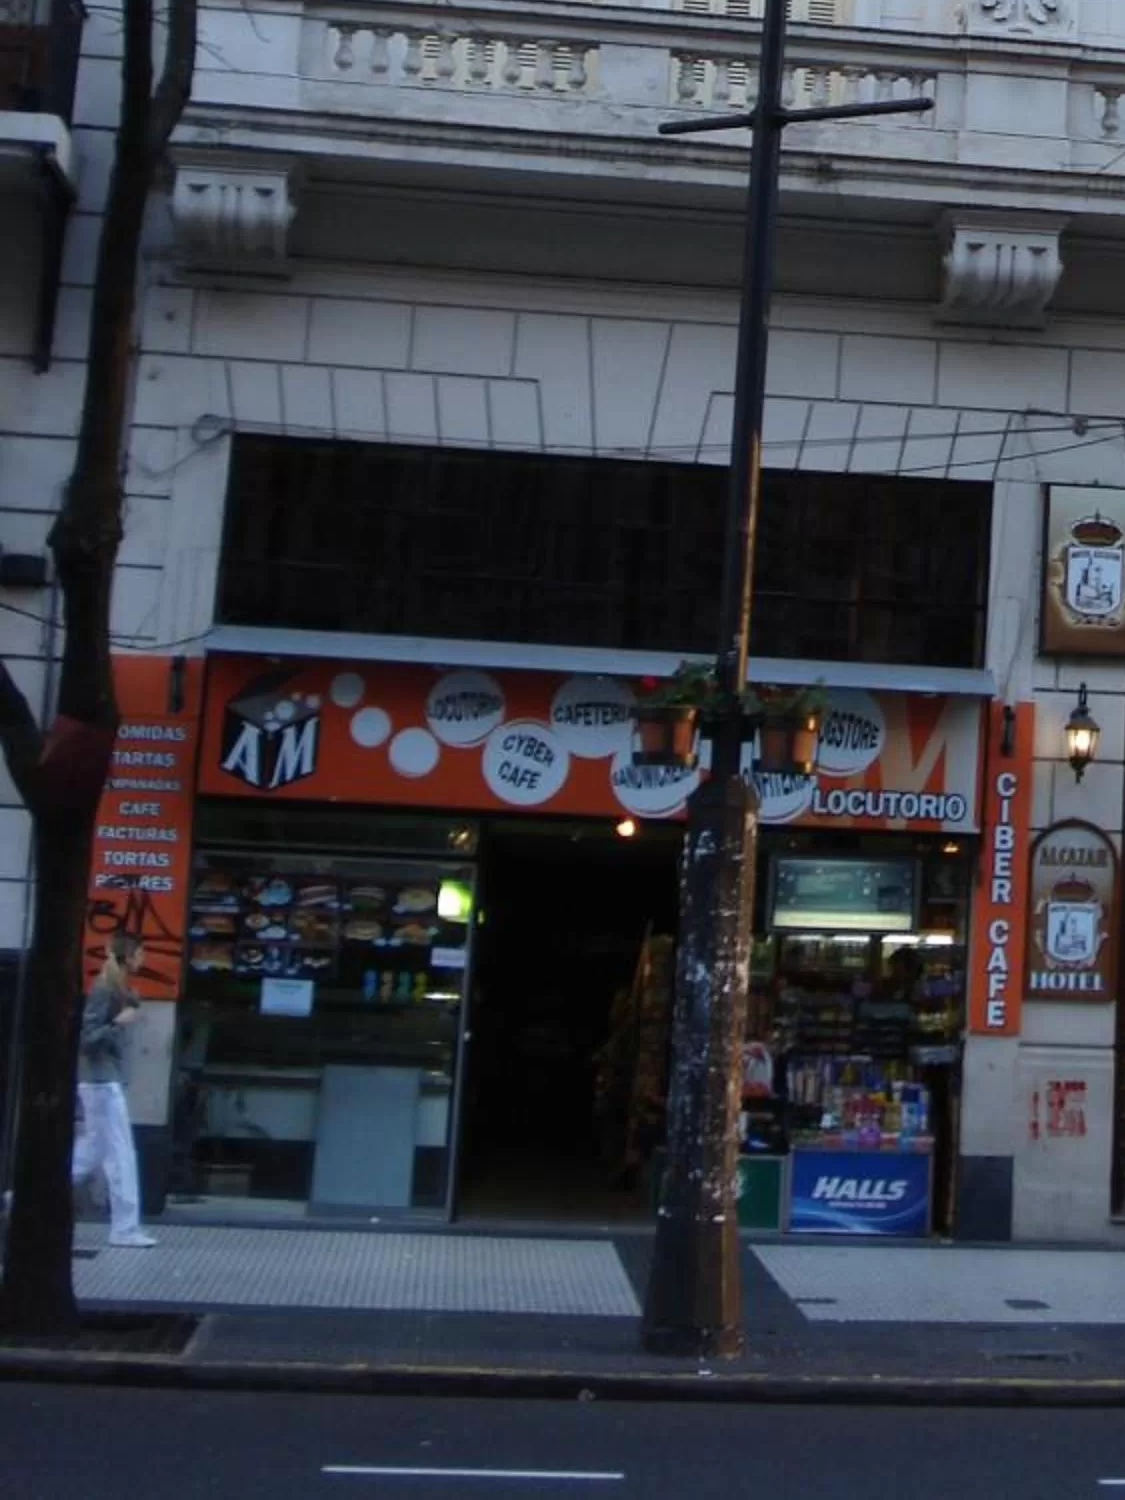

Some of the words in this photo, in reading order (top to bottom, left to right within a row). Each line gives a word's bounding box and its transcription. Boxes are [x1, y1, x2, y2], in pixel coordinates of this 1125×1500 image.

[117, 724, 187, 741] OMIDAS
[111, 751, 175, 767] TARTAS
[497, 760, 542, 790] CAFE
[118, 801, 161, 816] CAFE
[814, 788, 967, 821] LOCUTORIO
[97, 825, 177, 841] FACTURAS
[991, 772, 1017, 903] CIBER
[103, 851, 170, 866] TORTAS
[986, 920, 1010, 1028] CAFE
[1029, 971, 1103, 991] HOTEL
[811, 1175, 908, 1201] HALLS
